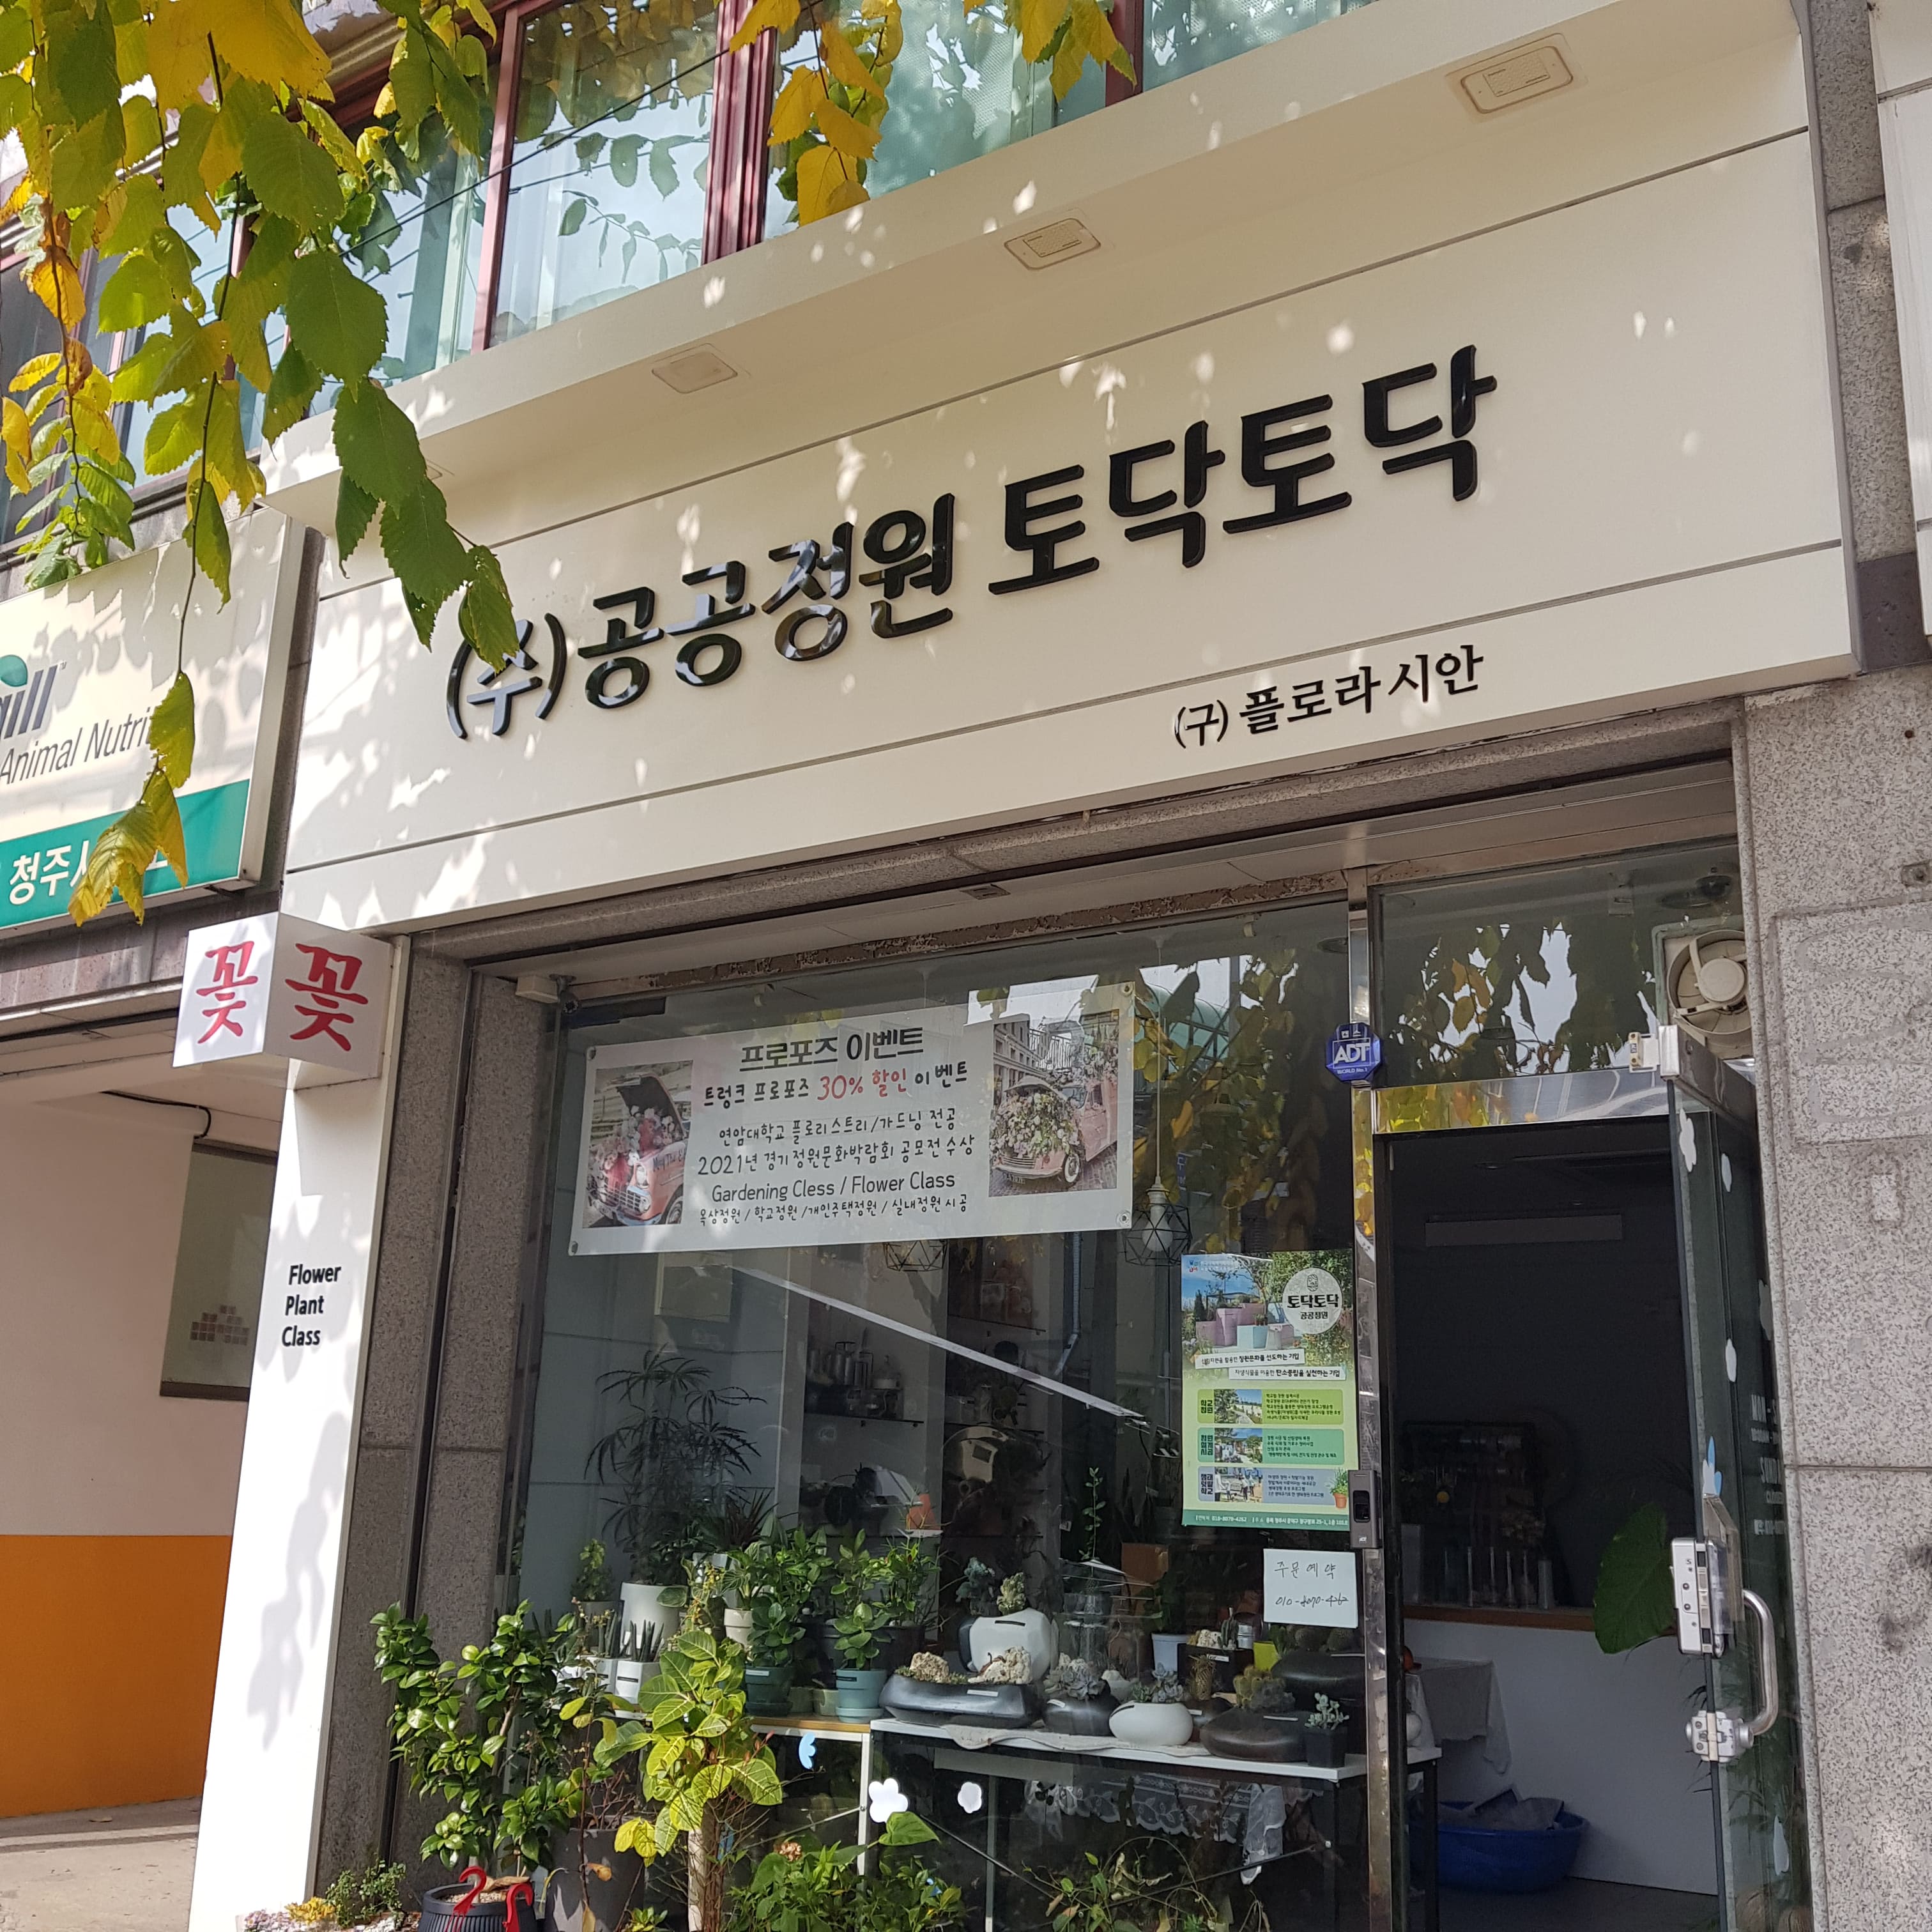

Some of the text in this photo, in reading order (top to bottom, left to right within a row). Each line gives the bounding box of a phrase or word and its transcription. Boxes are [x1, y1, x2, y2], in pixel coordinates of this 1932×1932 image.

[988, 344, 1498, 595] 토닥토닥
[1174, 645, 1483, 748] (구) 플로라시안
[0, 707, 151, 785] Animal Nutri
[196, 941, 257, 1045] 꽃
[285, 943, 369, 1052] 꽃
[740, 1027, 923, 1072] 프로포즈 이벤트
[1333, 1042, 1370, 1064] ADT
[704, 1061, 967, 1109] 트렁크 프로포즈 30% 할인 이벤트
[719, 1123, 785, 1146] 연암대학교
[929, 1108, 956, 1131] 전공
[698, 1154, 758, 1176] 2021년
[766, 1150, 788, 1170] 경기
[901, 1140, 940, 1163] 공모전
[946, 1134, 975, 1156] 수상
[712, 1183, 788, 1203] Gardening
[792, 1177, 835, 1198] Cless
[852, 1174, 905, 1194] Flower
[909, 1171, 956, 1190] Class
[700, 1208, 741, 1227] 옥상정원
[755, 1204, 798, 1222] 학교정원
[891, 1195, 942, 1217] 실내정원
[945, 1194, 967, 1213] 시공
[288, 1264, 342, 1285] Flower
[285, 1294, 325, 1316] Plant
[1287, 1294, 1339, 1308] 토닥토닥
[282, 1325, 321, 1347] Class
